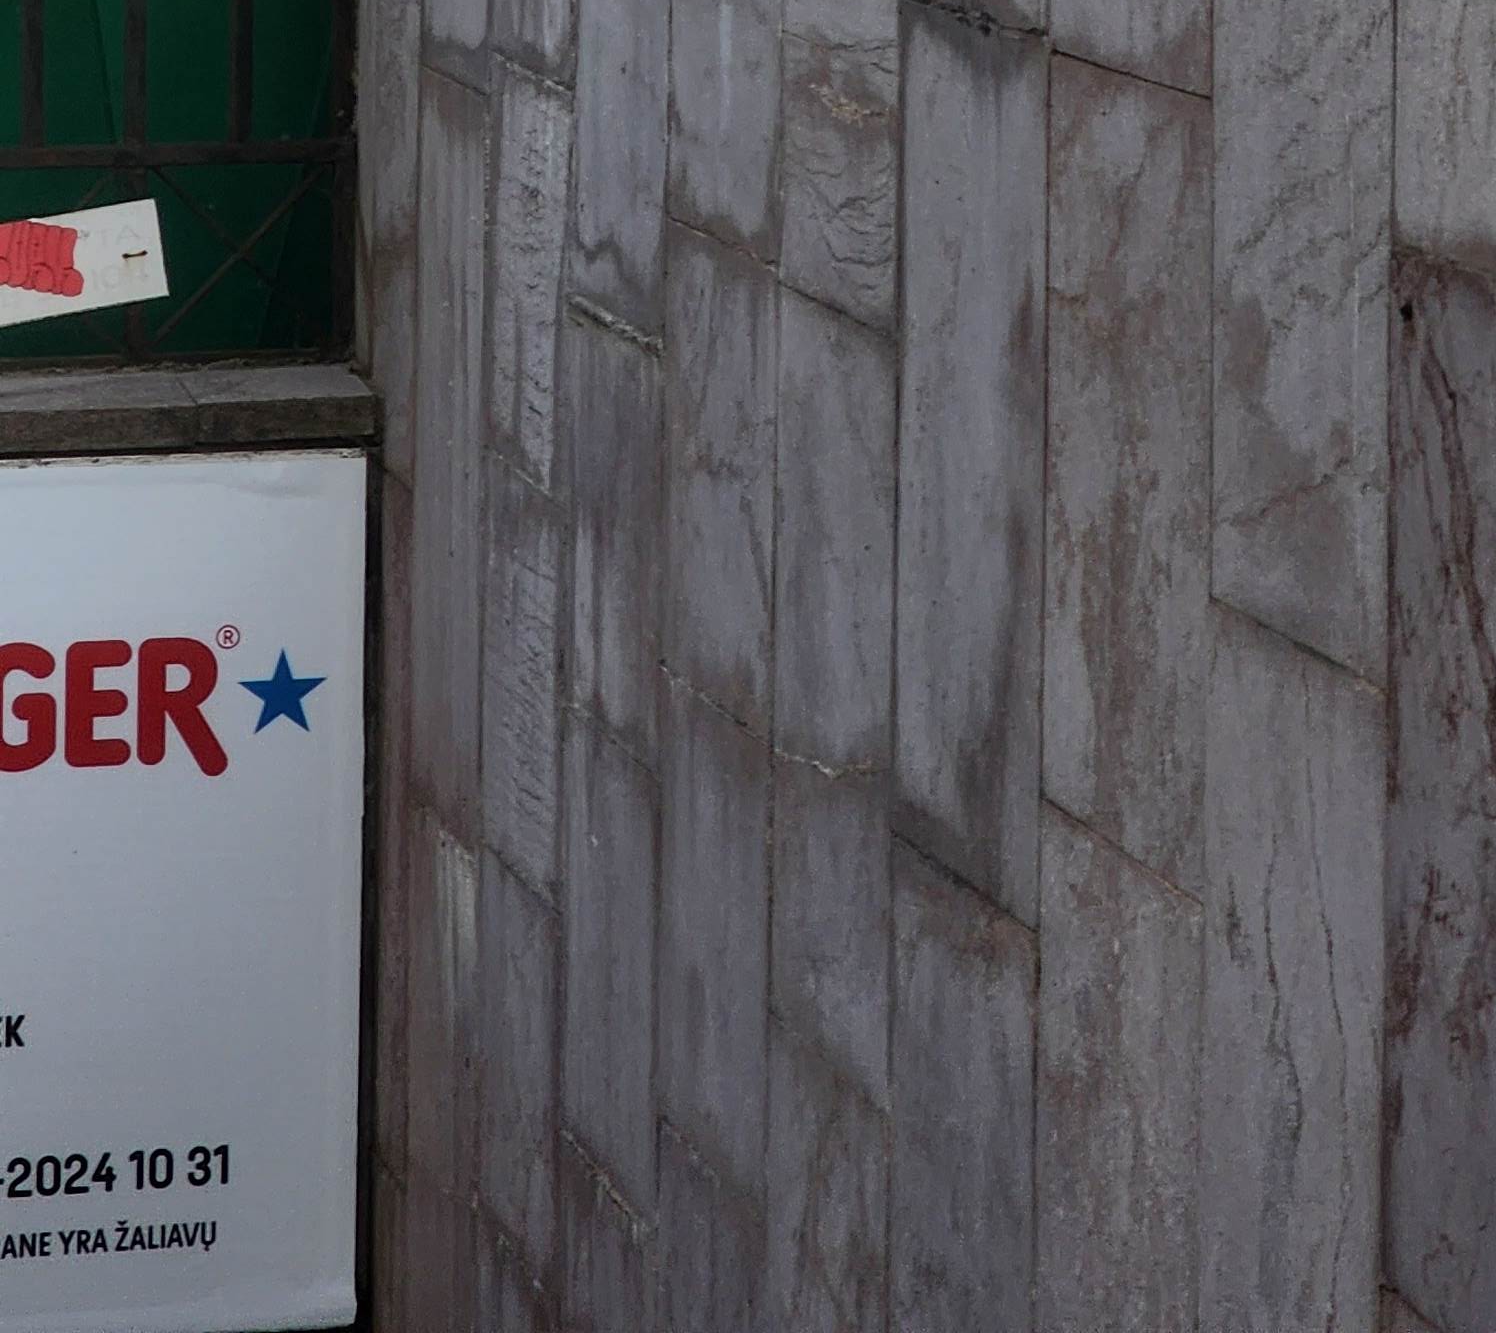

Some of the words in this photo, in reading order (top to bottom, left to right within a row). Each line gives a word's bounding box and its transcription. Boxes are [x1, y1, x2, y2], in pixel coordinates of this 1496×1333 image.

[0, 1014, 26, 1049] K
[128, 1148, 174, 1190] 10
[187, 1144, 230, 1187] 31
[0, 1232, 52, 1260] ANE
[58, 1229, 109, 1256] YRA
[114, 1219, 217, 1252] ŽALIAVŲ
